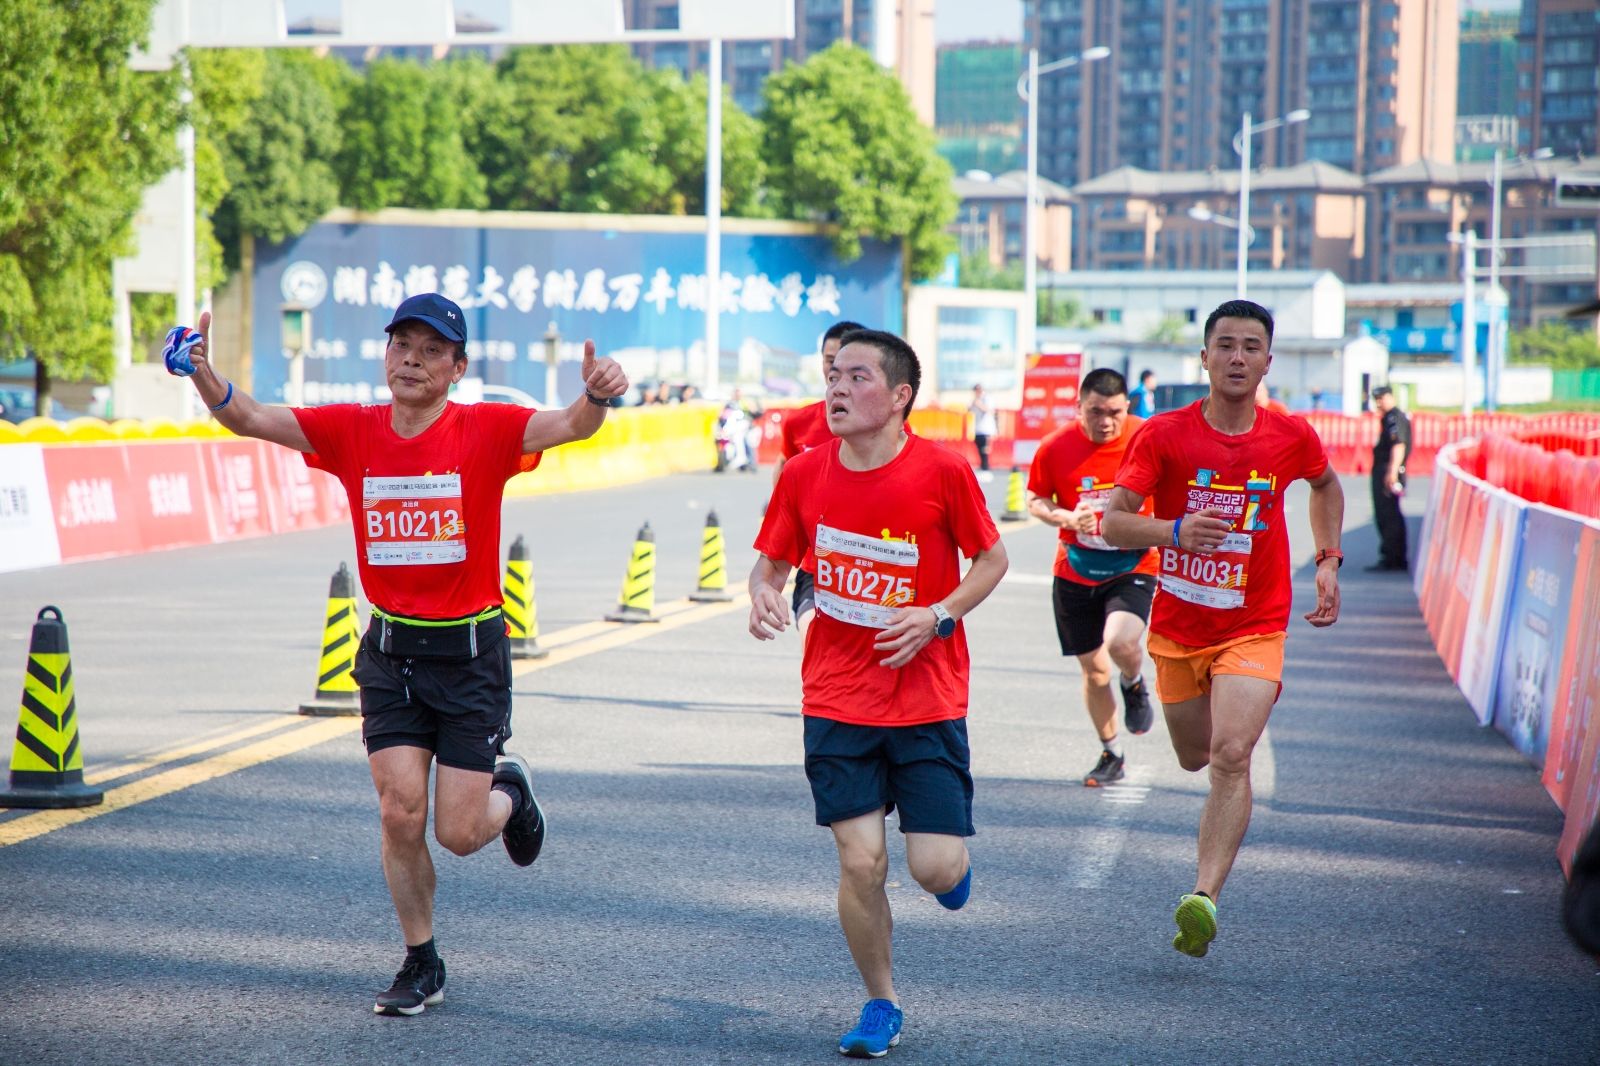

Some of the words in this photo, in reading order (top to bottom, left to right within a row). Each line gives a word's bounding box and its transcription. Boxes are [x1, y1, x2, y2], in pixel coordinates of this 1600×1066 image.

[447, 310, 457, 320] M
[1214, 493, 1246, 505] 2021
[366, 509, 459, 538] B10213
[817, 559, 912, 604] B10275
[1162, 548, 1244, 587] B10031
